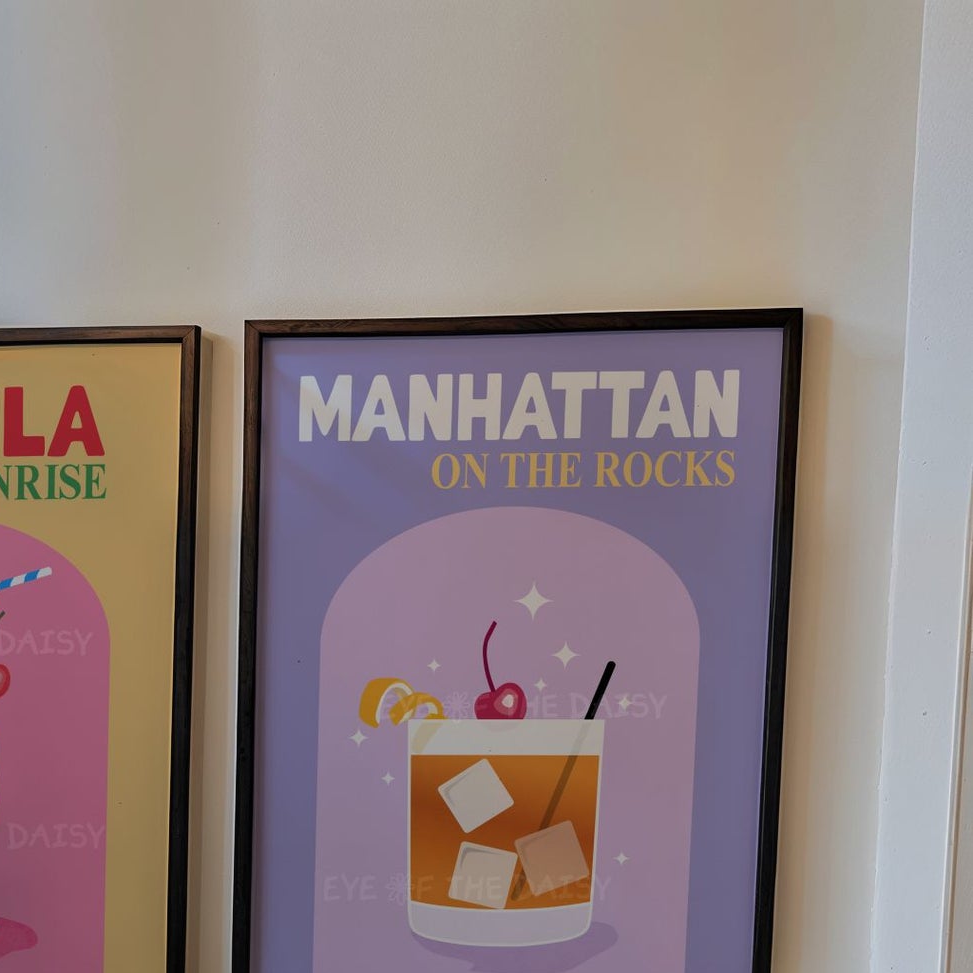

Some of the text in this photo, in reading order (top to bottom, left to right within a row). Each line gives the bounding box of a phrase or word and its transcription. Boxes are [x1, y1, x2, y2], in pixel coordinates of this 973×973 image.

[298, 369, 740, 442] MANHATTAN
[431, 449, 736, 489] ON THE ROCKS
